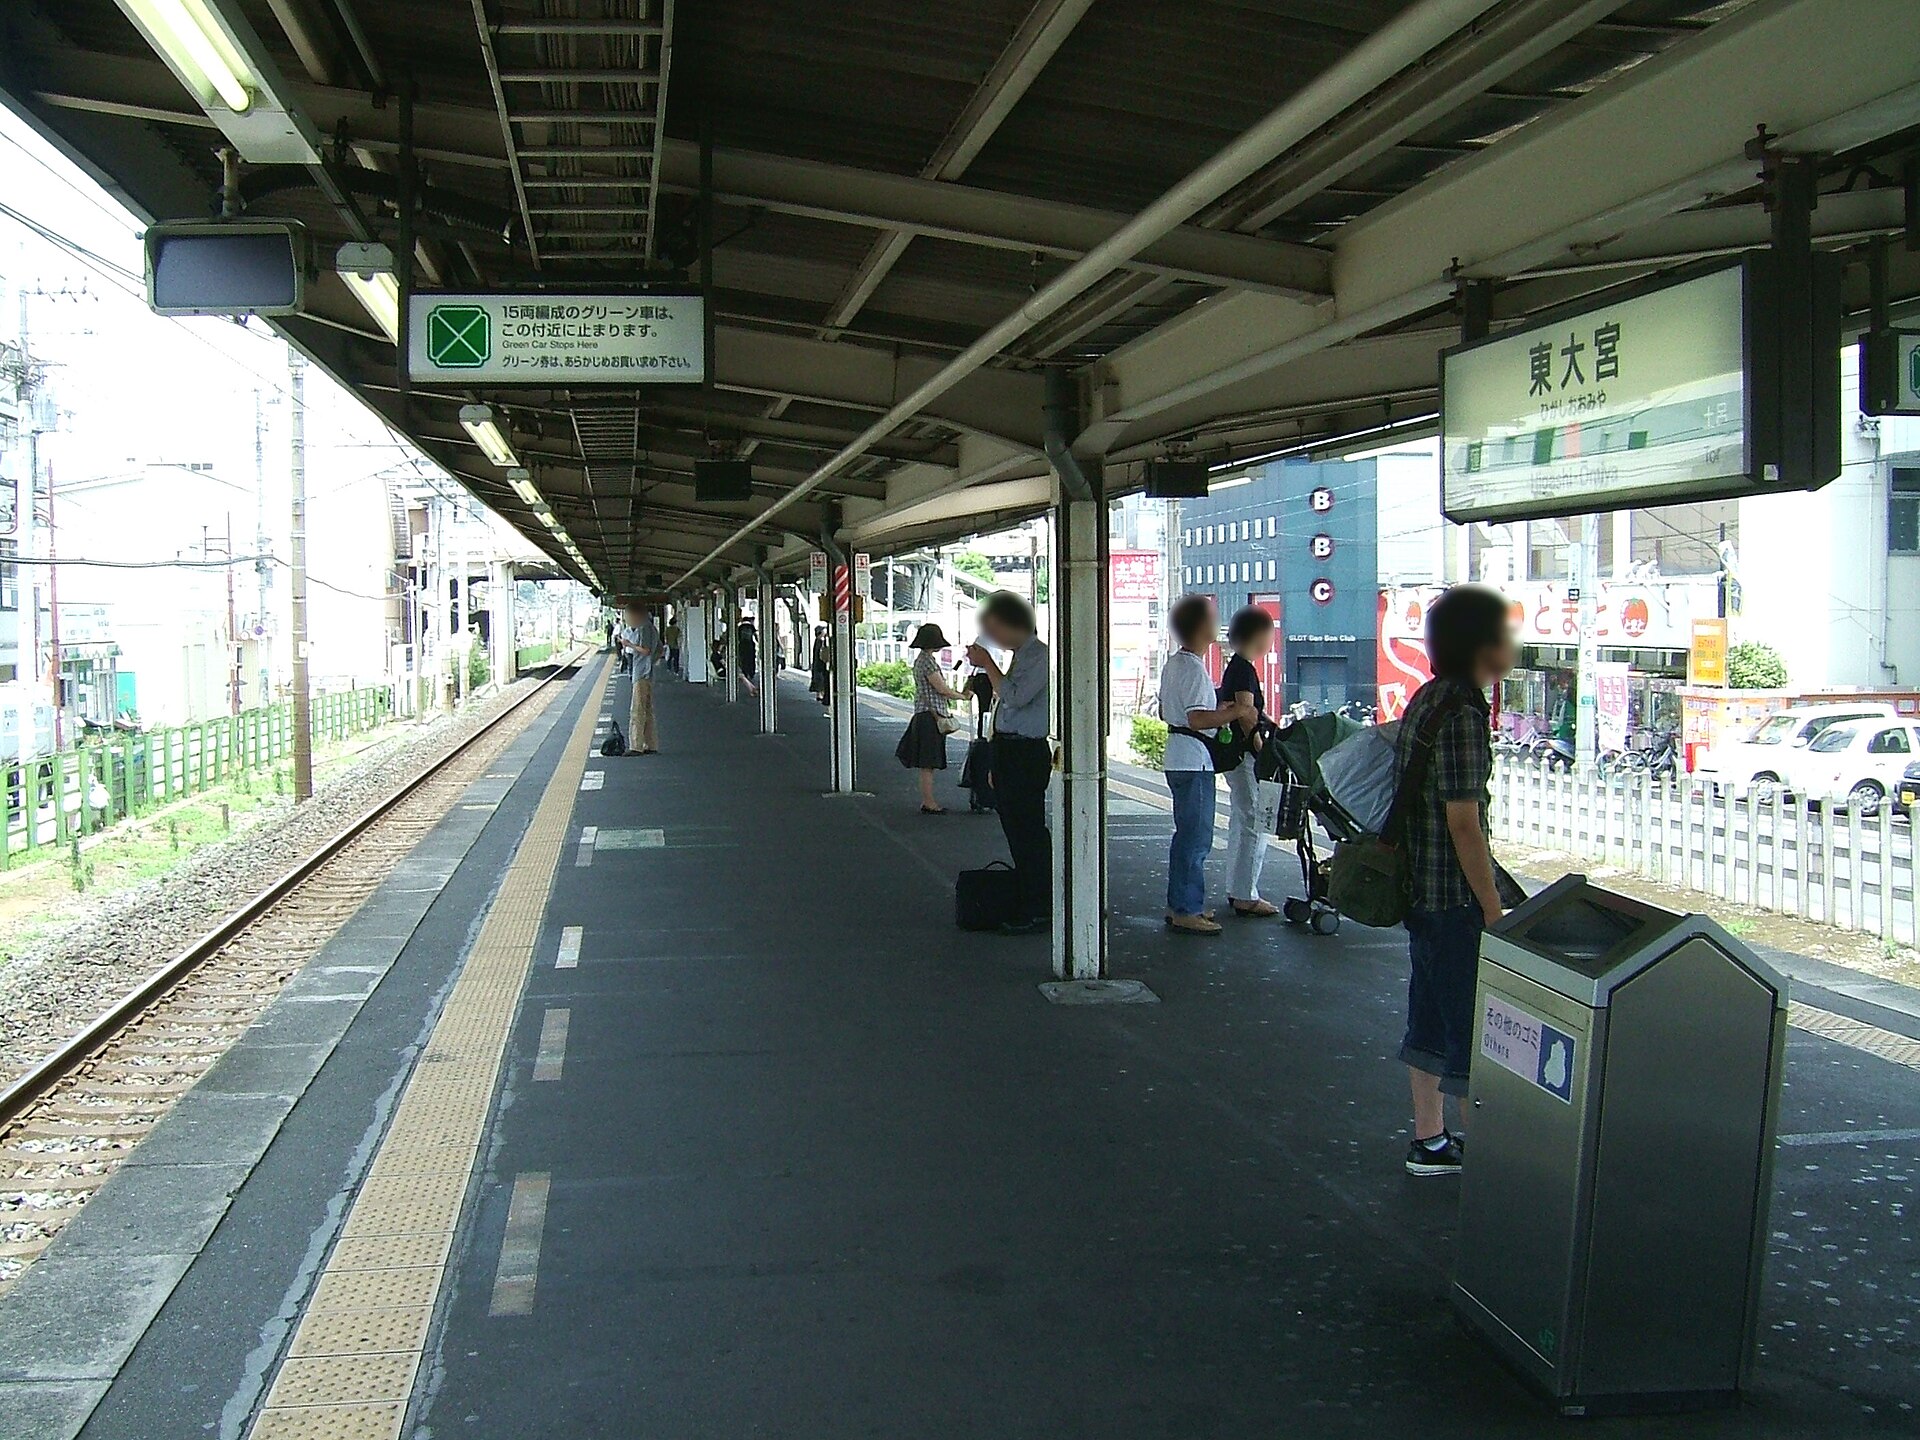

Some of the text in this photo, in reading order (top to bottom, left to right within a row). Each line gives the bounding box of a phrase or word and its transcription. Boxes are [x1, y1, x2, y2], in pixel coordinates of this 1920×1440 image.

[502, 305, 675, 320] 15両編成のグリーン車は、
[502, 323, 659, 338] この付近に止まります。
[502, 340, 599, 351] Green Car Stops Here
[502, 355, 692, 368] グリーン券は、あらかじめお買い求め下さい。
[1530, 322, 1621, 396] 東大宮
[1540, 389, 1607, 421] ひがしおおみや
[1487, 1008, 1538, 1050] その他のゴミ
